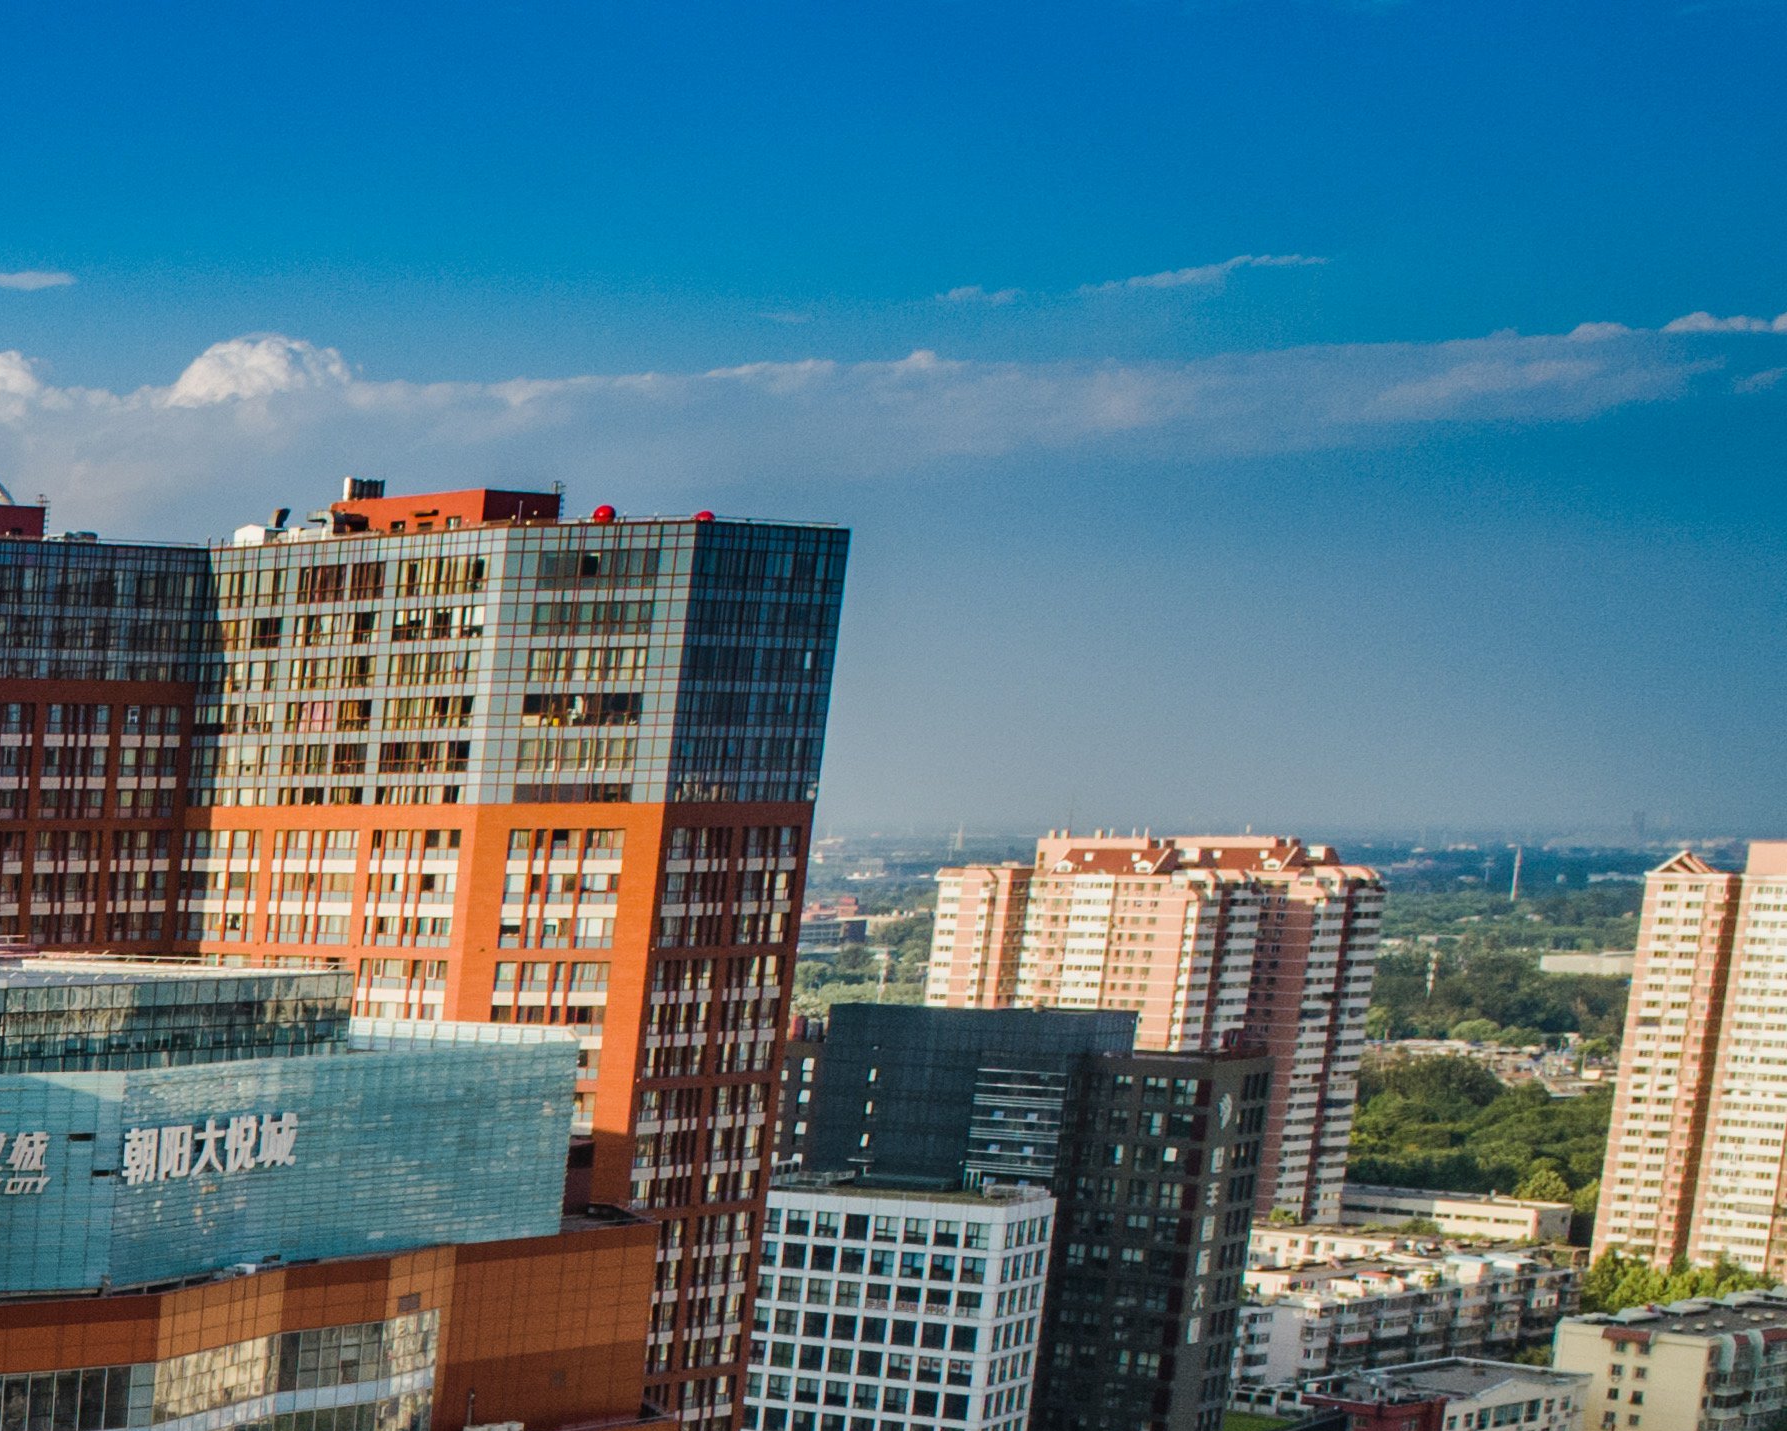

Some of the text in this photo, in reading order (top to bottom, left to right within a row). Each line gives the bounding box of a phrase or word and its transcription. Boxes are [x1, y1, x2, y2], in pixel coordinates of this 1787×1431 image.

[122, 1112, 298, 1186] 朝阳大悦城
[6, 1176, 50, 1193] CITY
